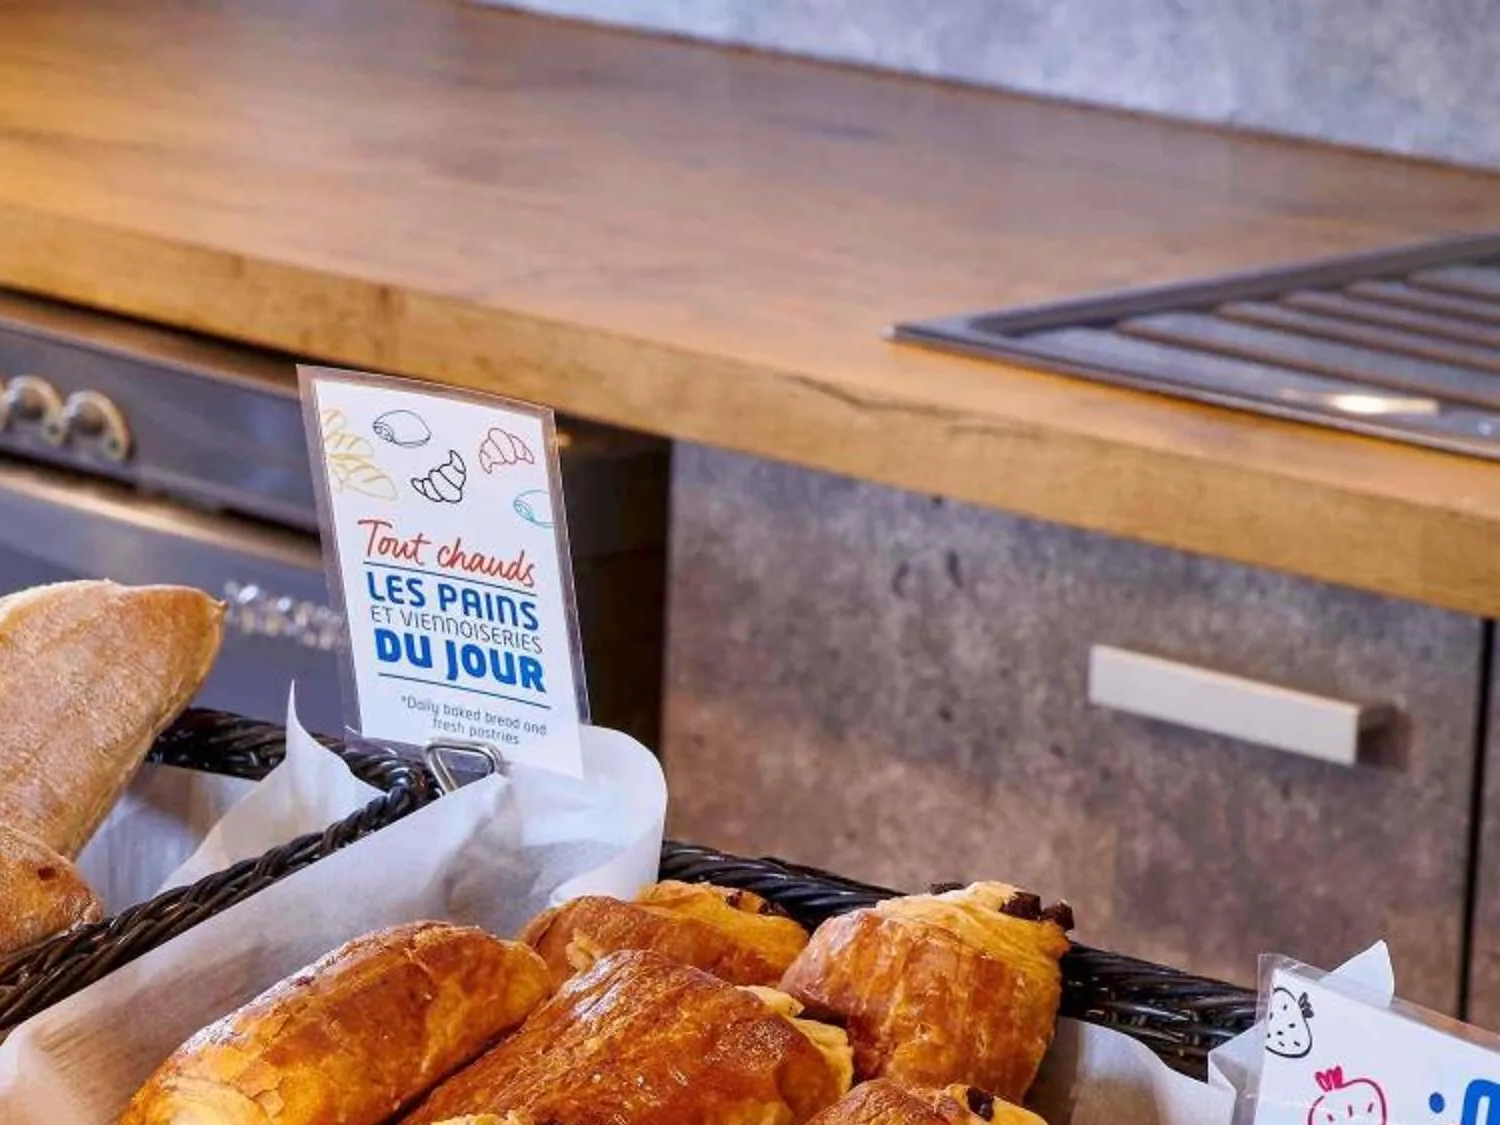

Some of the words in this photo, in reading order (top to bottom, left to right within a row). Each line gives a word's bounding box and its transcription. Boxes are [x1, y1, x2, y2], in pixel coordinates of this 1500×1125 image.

[357, 519, 432, 566] Tout
[436, 537, 536, 588] chauds
[366, 571, 427, 609] LES
[437, 582, 540, 632] PAINS
[371, 605, 393, 625] ET
[399, 610, 543, 654] VIENNOISERIES
[374, 627, 433, 669] DU
[445, 639, 547, 694] JOUR
[432, 717, 465, 734] fresh
[469, 726, 520, 745] pastries
[443, 703, 482, 721] baked
[485, 711, 521, 730] bread
[523, 722, 548, 738] and
